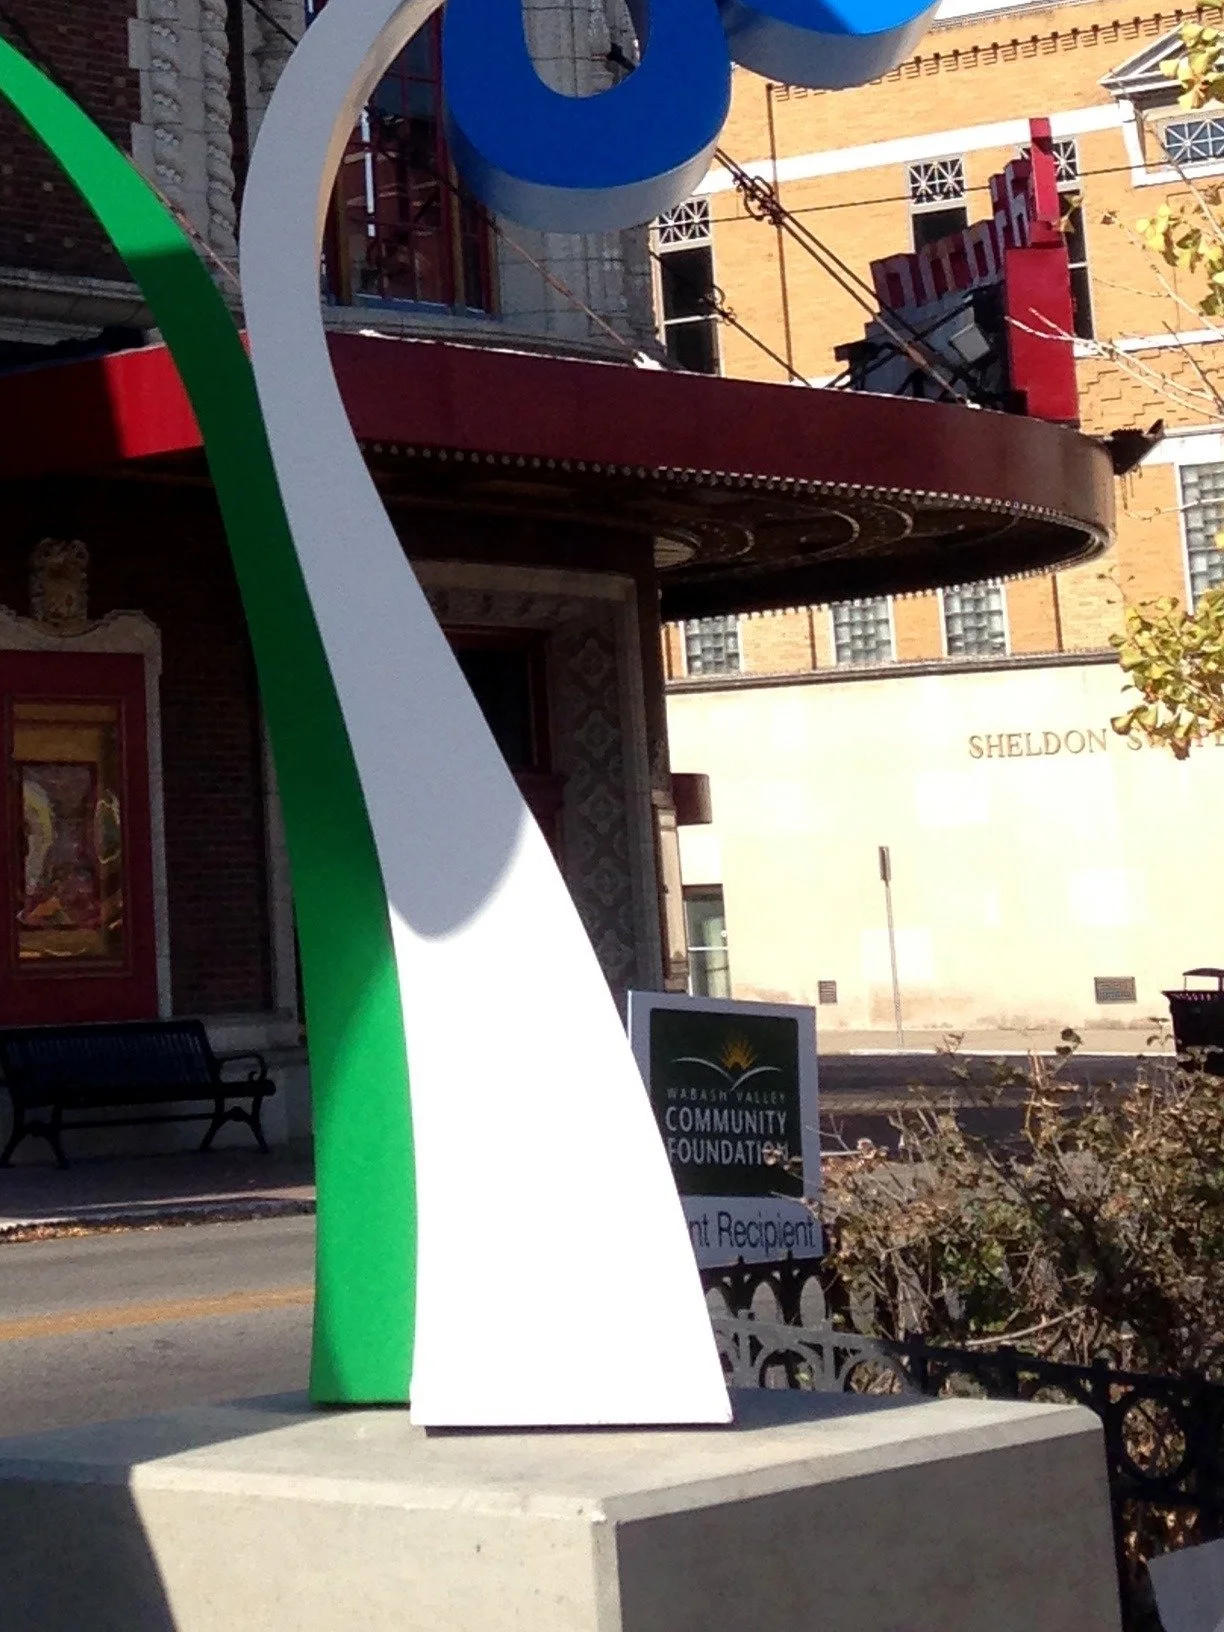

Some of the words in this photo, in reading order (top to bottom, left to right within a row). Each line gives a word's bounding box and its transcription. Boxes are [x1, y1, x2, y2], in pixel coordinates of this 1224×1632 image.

[968, 728, 1107, 759] SHELDON
[667, 1087, 727, 1101] WABASH
[736, 1091, 786, 1104] VALLEY
[666, 1106, 787, 1135] COMMUNITY
[717, 1210, 815, 1257] Recipient
